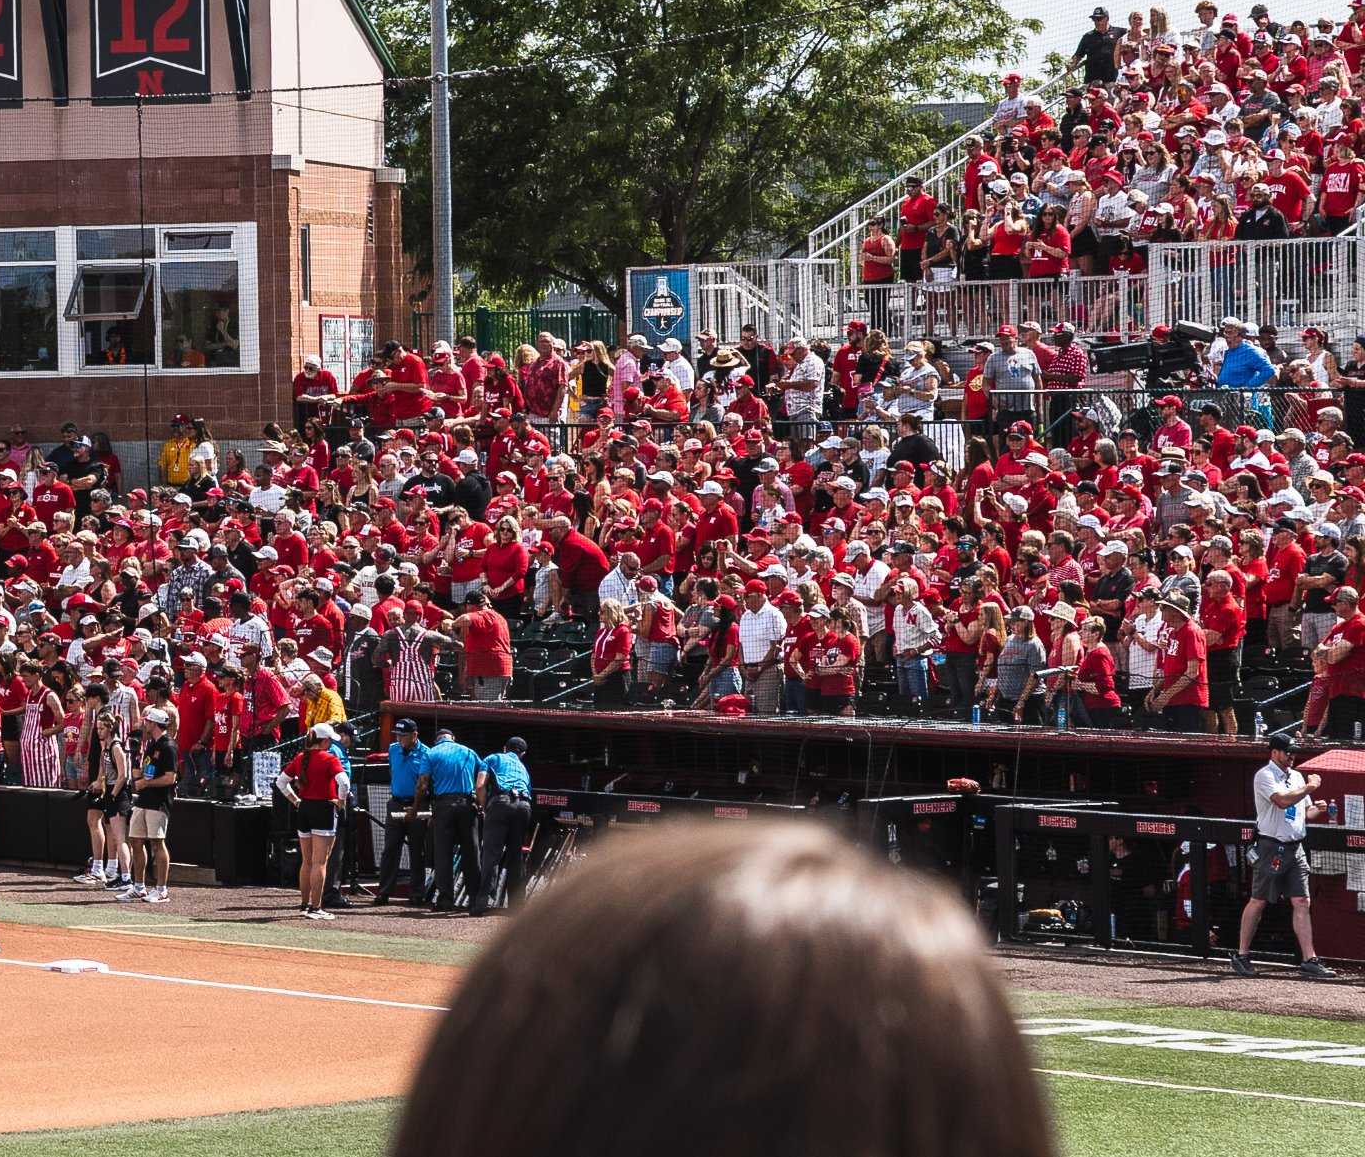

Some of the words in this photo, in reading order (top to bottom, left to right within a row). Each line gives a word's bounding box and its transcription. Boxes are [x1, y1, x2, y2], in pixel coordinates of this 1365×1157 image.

[138, 69, 165, 96] N
[913, 801, 957, 814] HUSKERS
[1038, 814, 1077, 829] HUSKERS
[1136, 821, 1176, 835] HUSKERS
